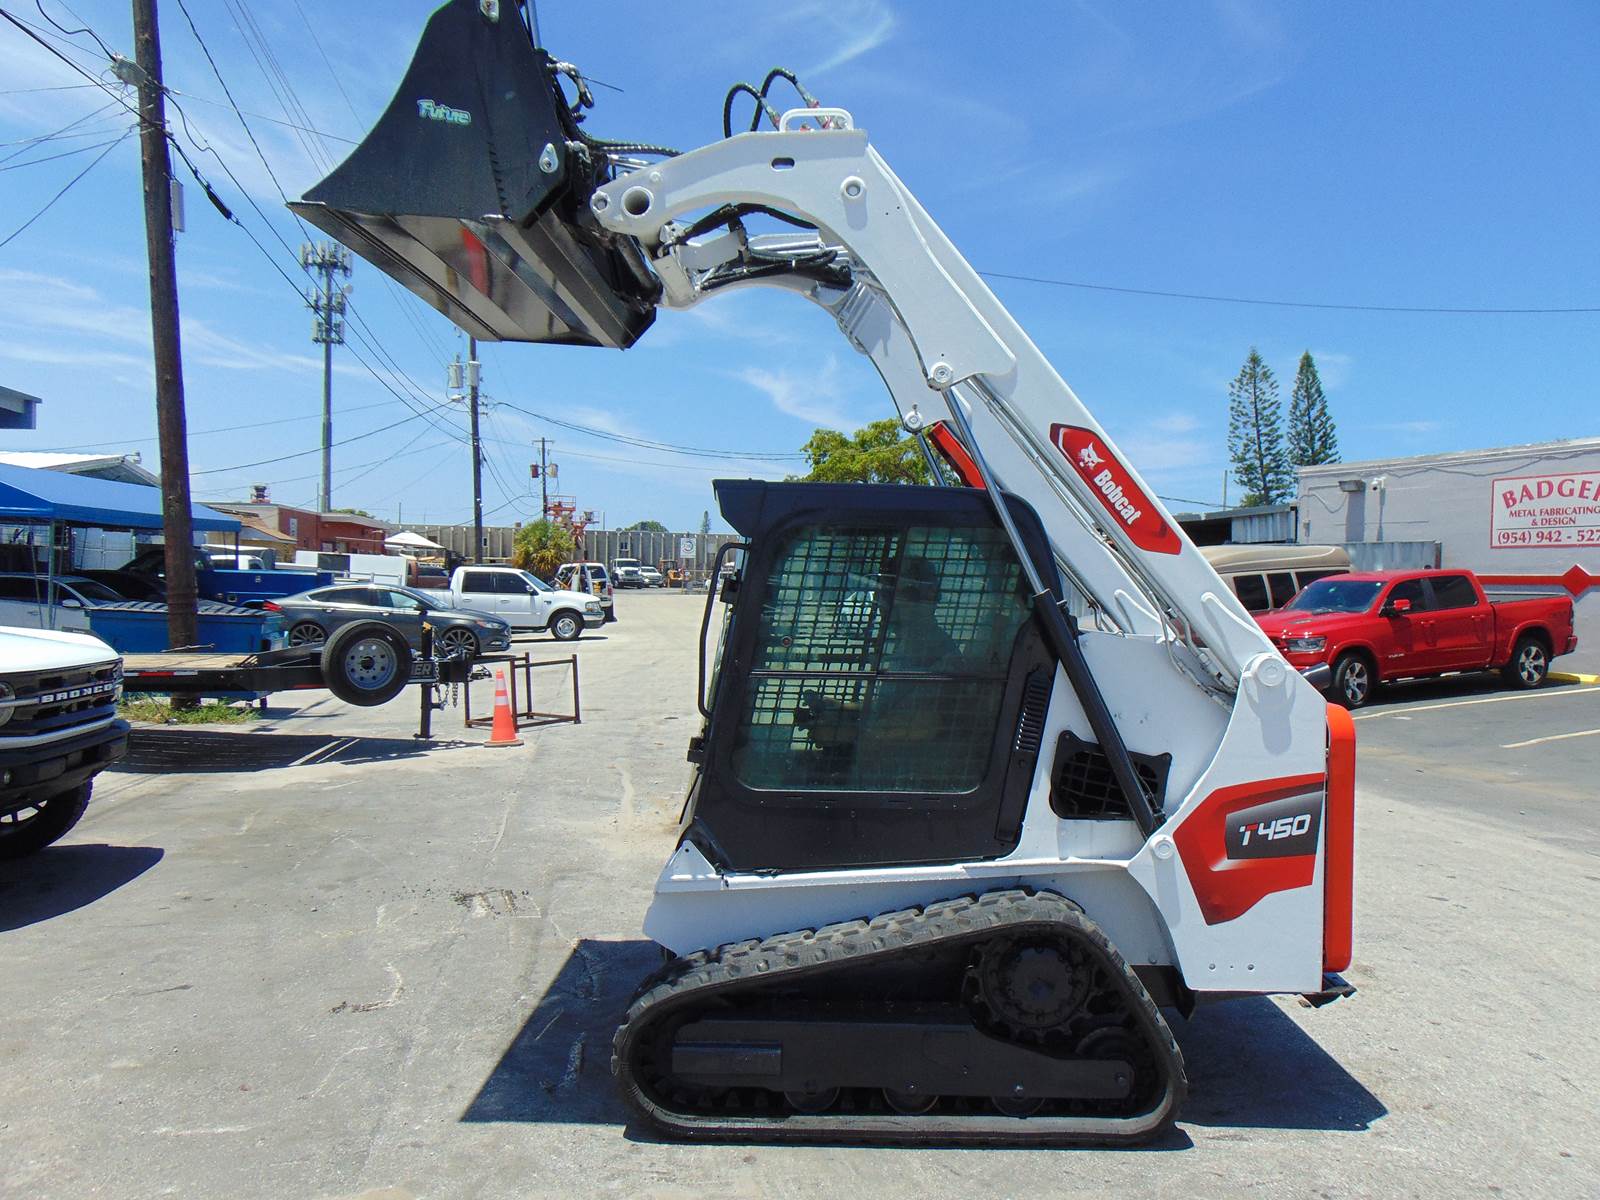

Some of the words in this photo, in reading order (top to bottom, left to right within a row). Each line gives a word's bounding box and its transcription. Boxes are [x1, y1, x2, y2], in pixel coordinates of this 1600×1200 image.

[417, 100, 471, 126] Future
[1094, 469, 1142, 525] Bobcat
[1509, 509, 1537, 518] METAL
[1540, 506, 1600, 516] FABRICATING
[1540, 517, 1576, 526] DESIGN
[1498, 530, 1532, 544] (954)
[1536, 530, 1562, 543] 942
[41, 683, 113, 703] BRONCO
[1239, 814, 1312, 846] T450
